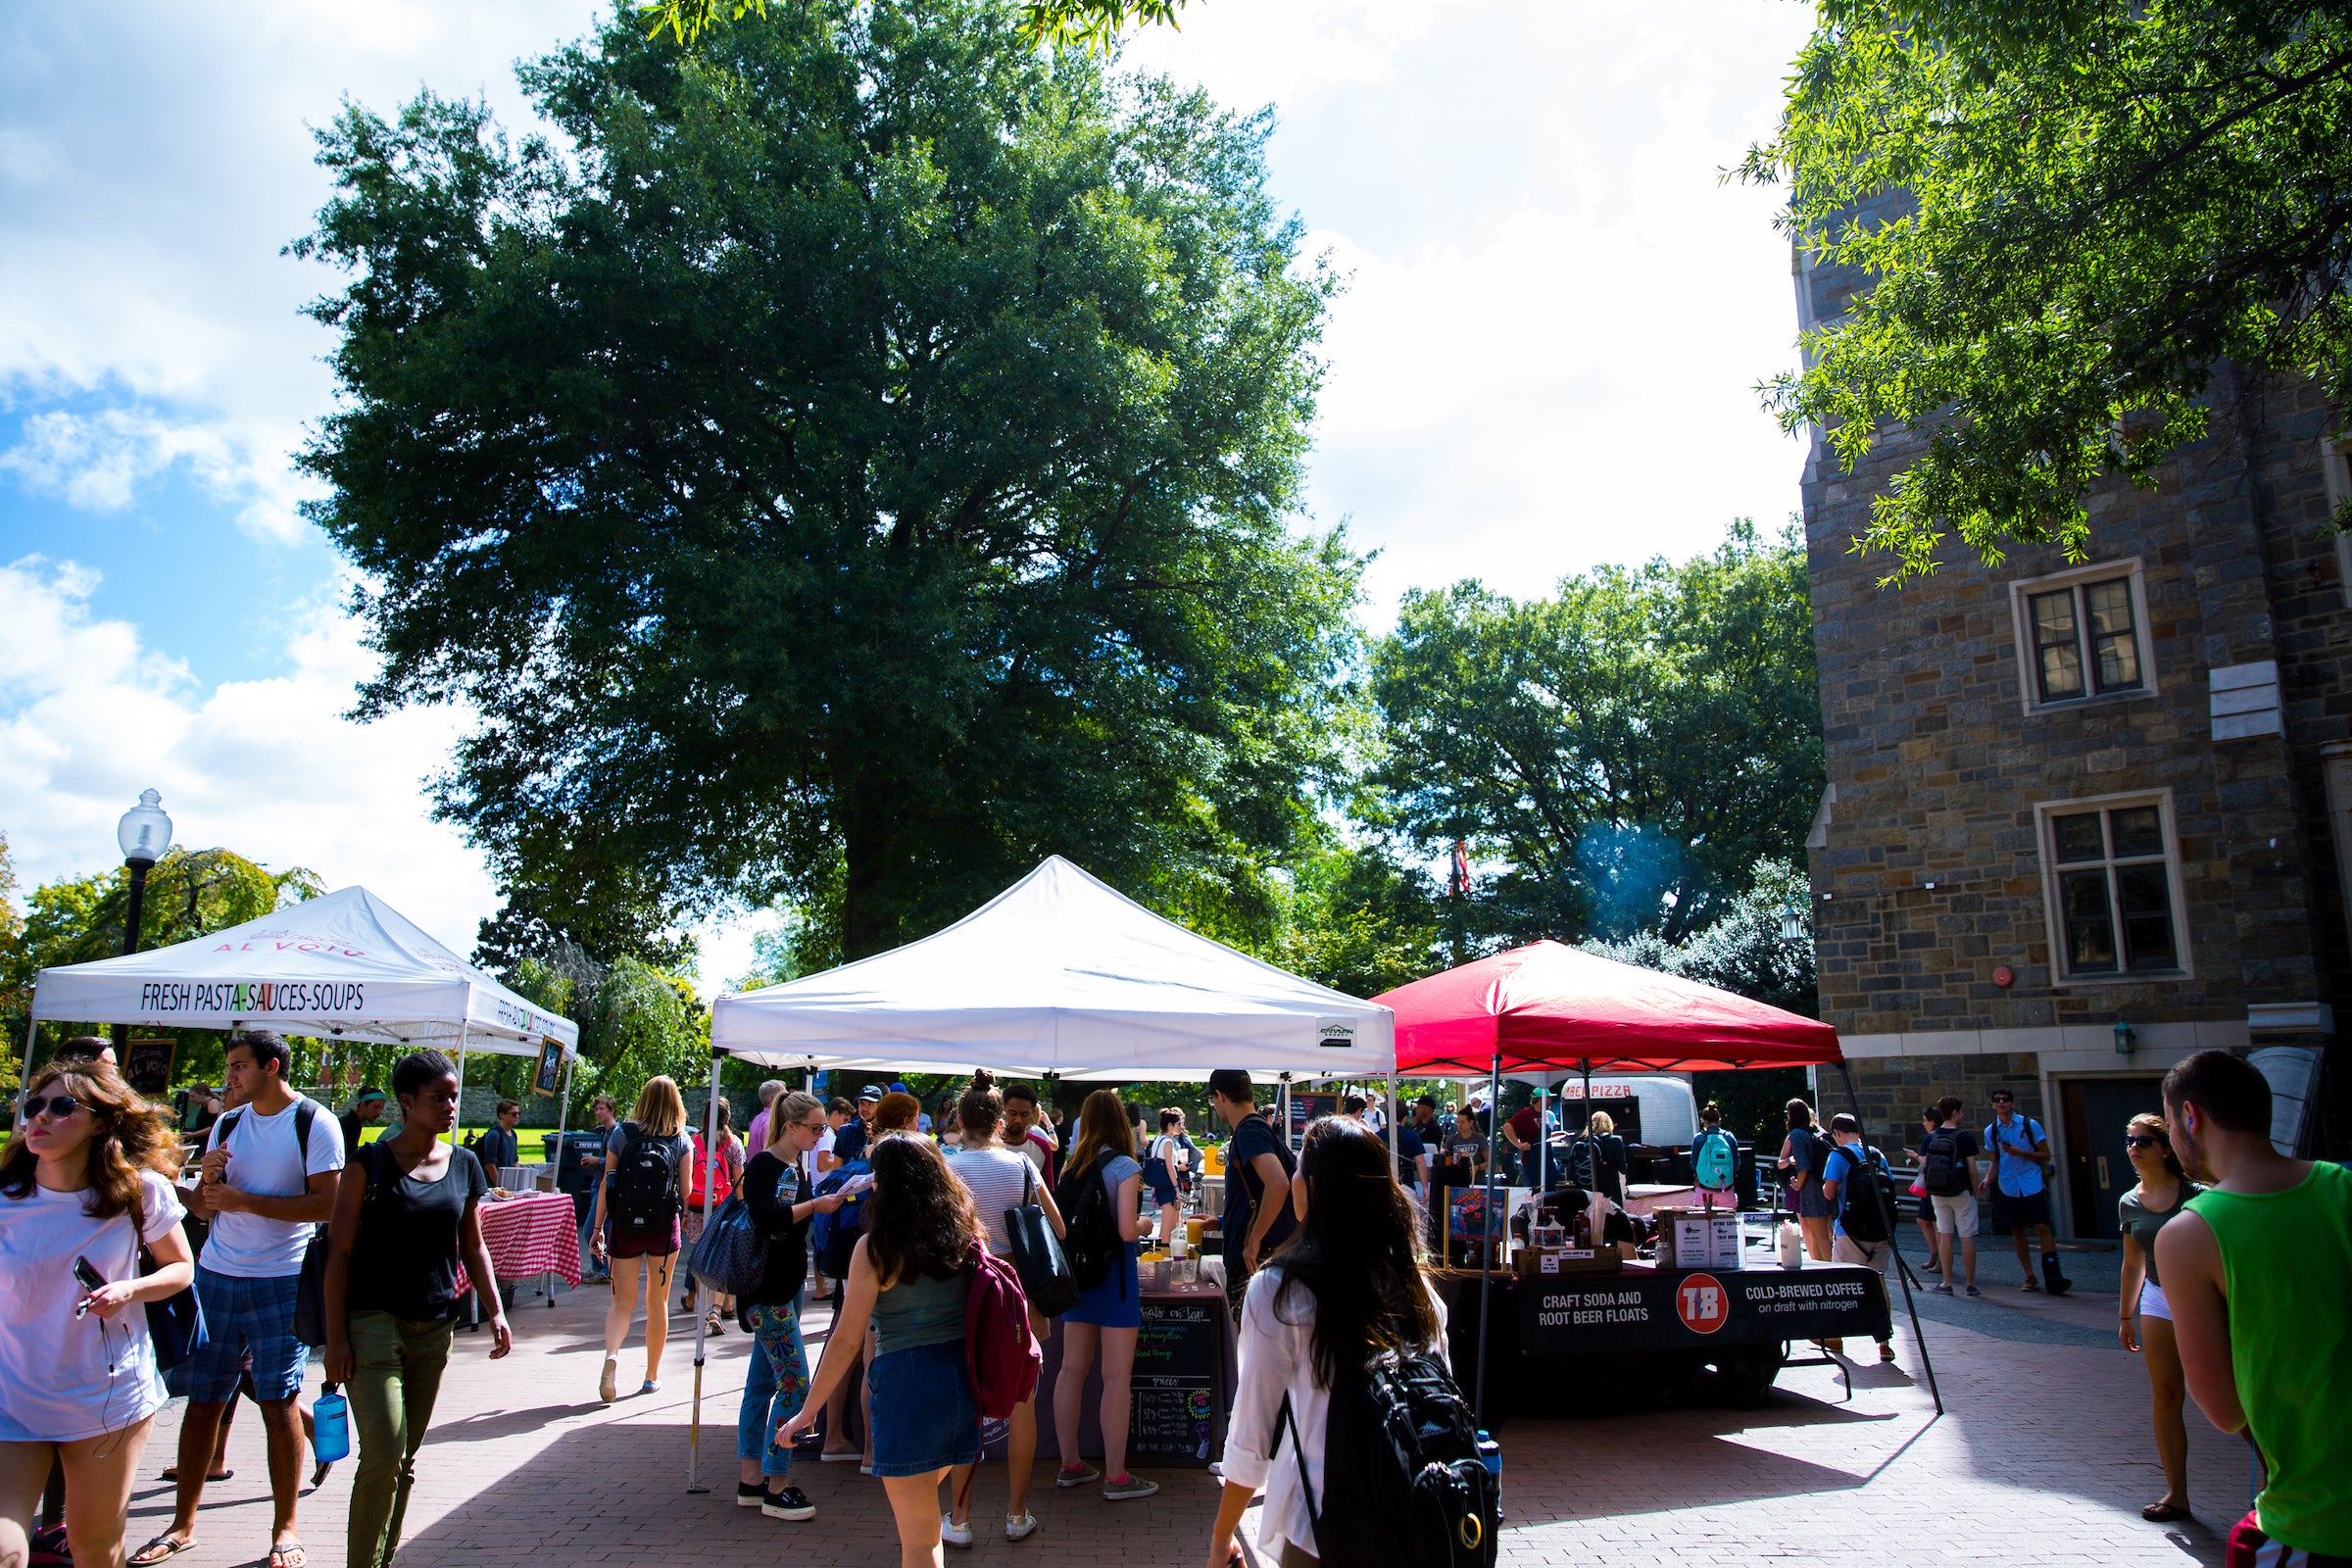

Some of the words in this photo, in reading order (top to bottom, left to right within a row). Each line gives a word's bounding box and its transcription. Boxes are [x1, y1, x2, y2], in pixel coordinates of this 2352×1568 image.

[213, 942, 254, 954] AL
[141, 983, 190, 1011] FRESH
[194, 983, 364, 1011] PASTA-SAUCES-SOUPS
[1592, 1085, 1631, 1097] PIZZA
[1745, 1286, 1823, 1300] COLD-BREWED
[1825, 1282, 1865, 1297] COFFEE
[1543, 1295, 1581, 1309] CRAFT
[1584, 1293, 1615, 1307] SODA
[1618, 1292, 1642, 1305] AND
[1758, 1303, 1772, 1314] on
[1774, 1300, 1796, 1313] draft
[1798, 1300, 1818, 1311] with
[1820, 1299, 1858, 1313] nitrogen
[1539, 1311, 1569, 1326] ROOT
[1573, 1309, 1603, 1324] BEER
[1606, 1307, 1648, 1323] FLOATS
